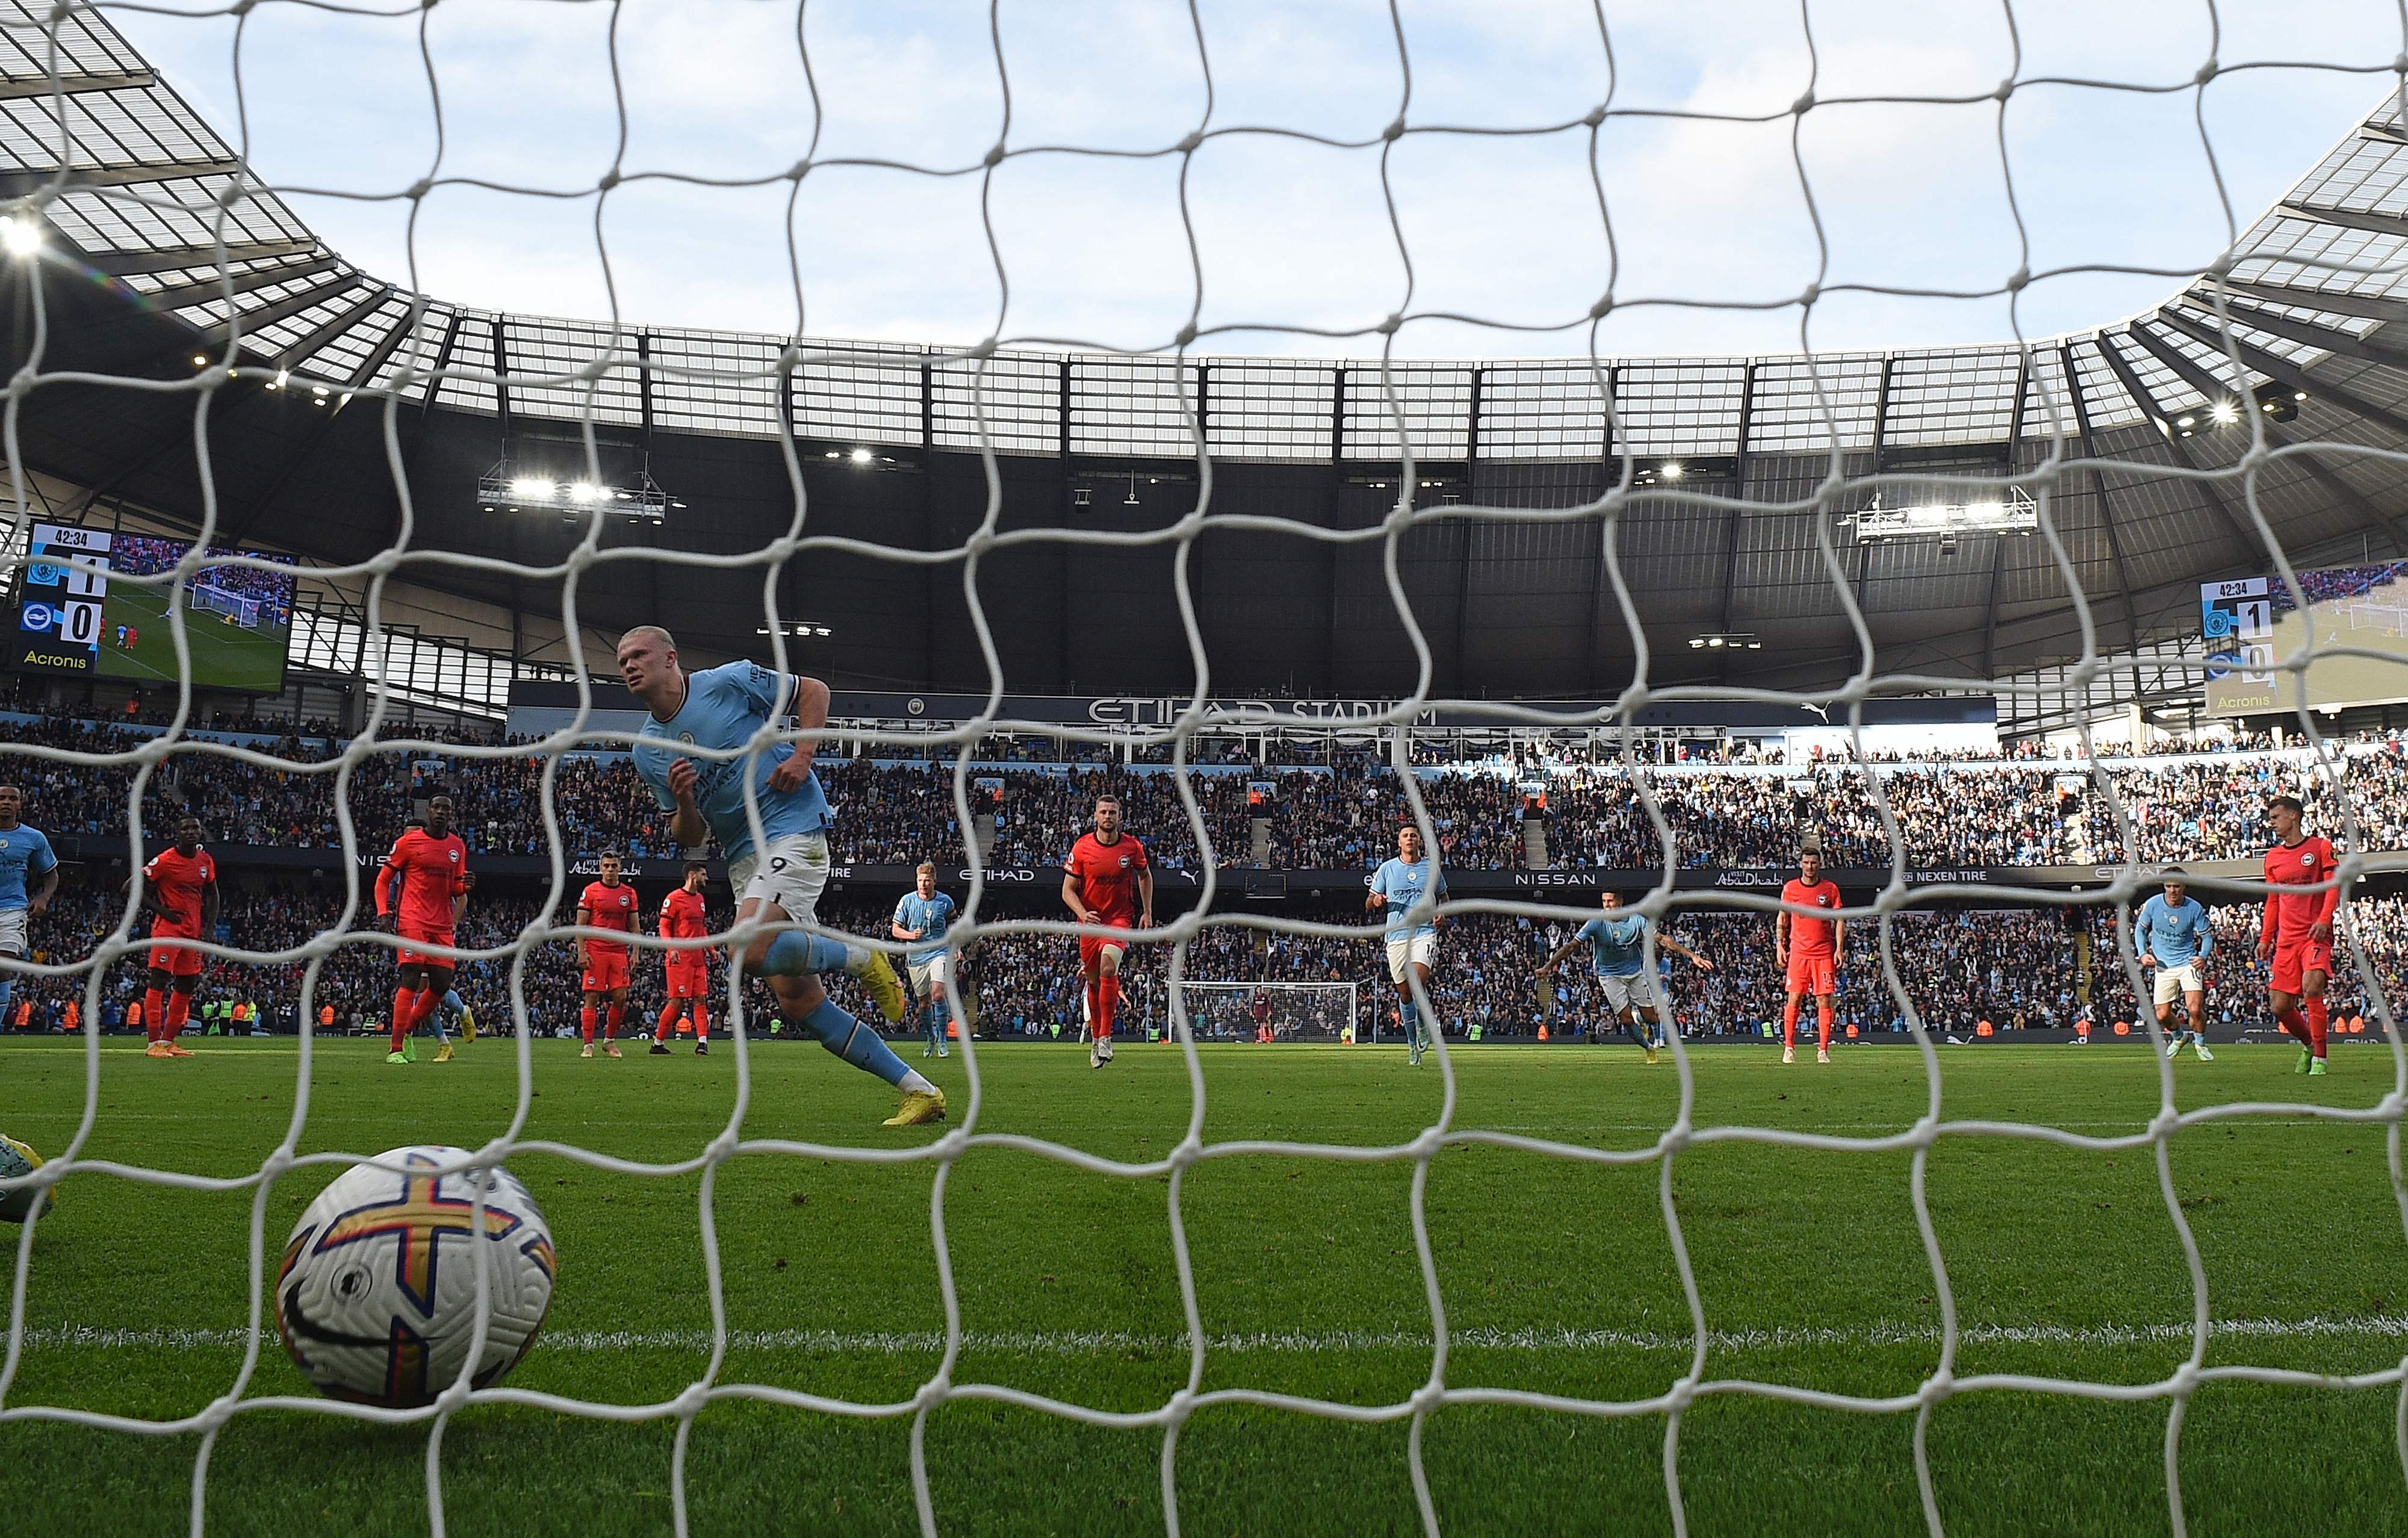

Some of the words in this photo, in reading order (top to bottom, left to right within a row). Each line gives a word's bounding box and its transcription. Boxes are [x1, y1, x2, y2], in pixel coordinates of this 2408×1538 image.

[55, 529, 88, 547] 42:34
[85, 558, 96, 593] 1
[2220, 582, 2247, 596] 42:34
[72, 605, 92, 640] 0
[2248, 603, 2261, 636] 1
[23, 650, 86, 669] Acronis
[2250, 647, 2265, 679] 0
[1088, 699, 1275, 724] ETIHAD
[2217, 696, 2270, 709] Acronis
[1515, 874, 1595, 885] NISSAN
[1714, 873, 1740, 885] Abu
[1746, 872, 1784, 885] Dhabi
[1917, 872, 1956, 882] NEXEN
[1959, 871, 1987, 881] TIRE
[2311, 947, 2322, 963] 7
